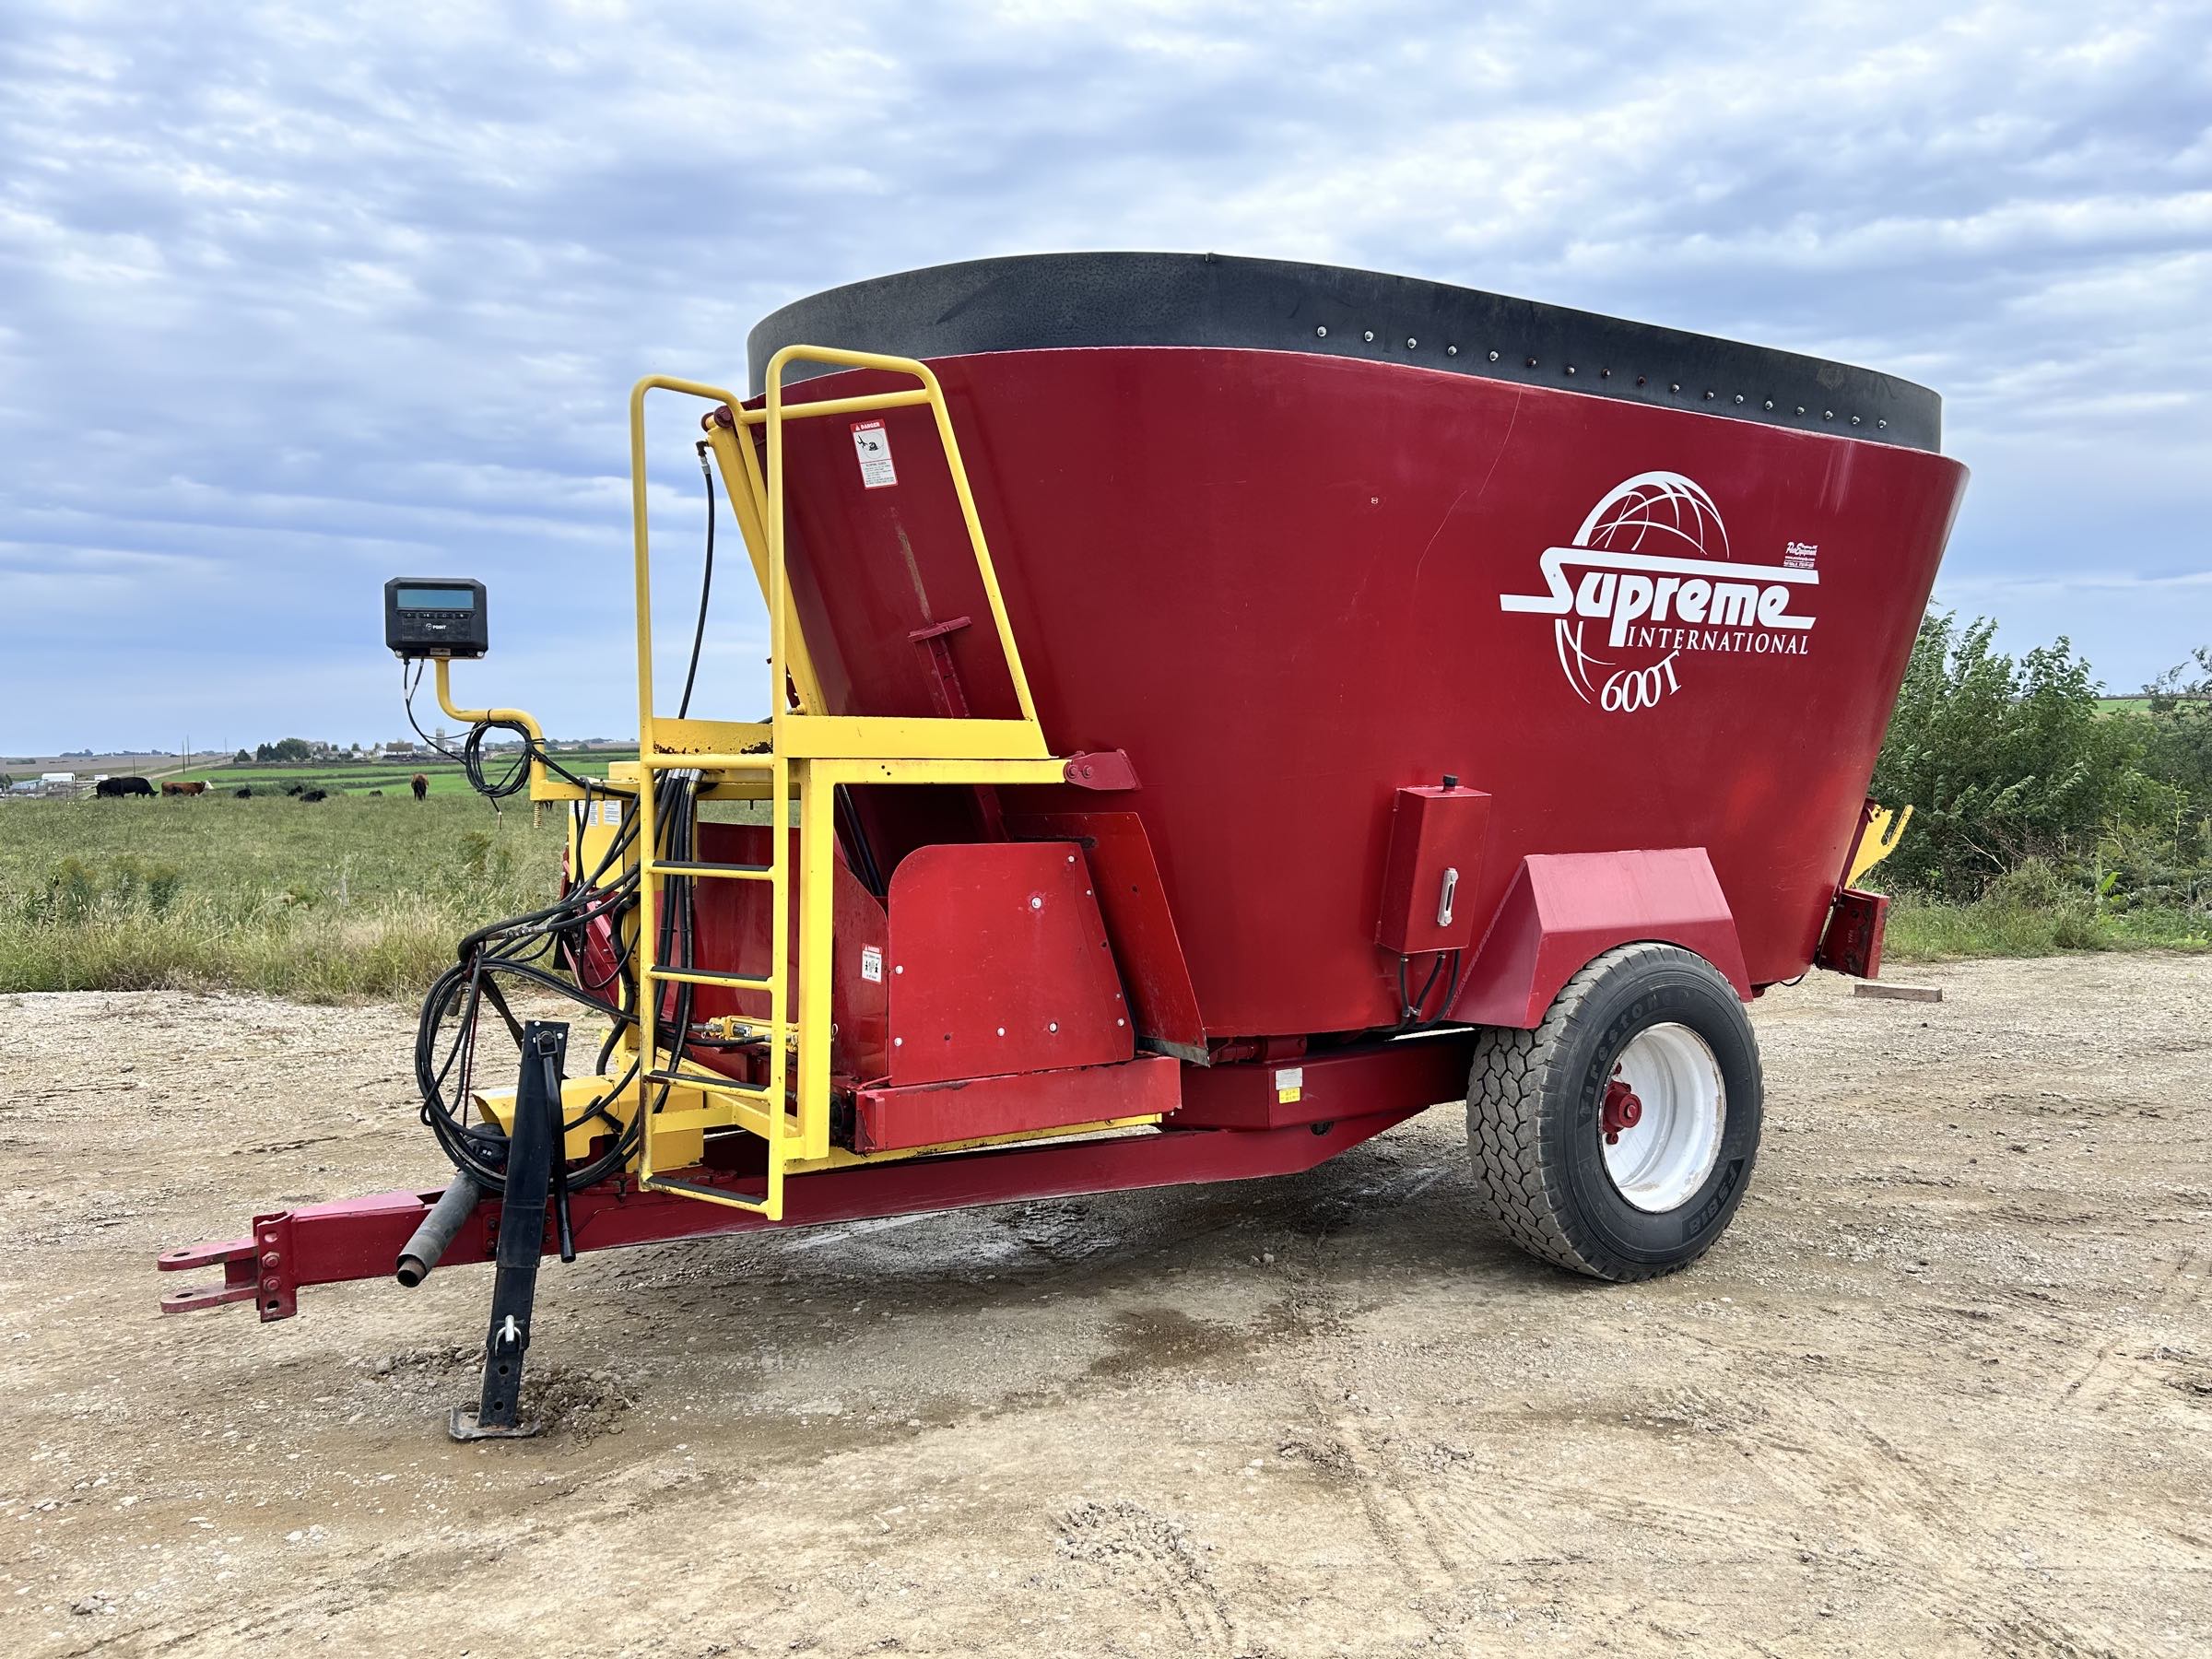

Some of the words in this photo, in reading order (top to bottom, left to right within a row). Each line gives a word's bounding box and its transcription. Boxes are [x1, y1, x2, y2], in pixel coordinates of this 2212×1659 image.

[1500, 547, 1819, 647] Supreme
[1628, 626, 1808, 654] INTERNATIONAL
[1600, 650, 1682, 712] 600T
